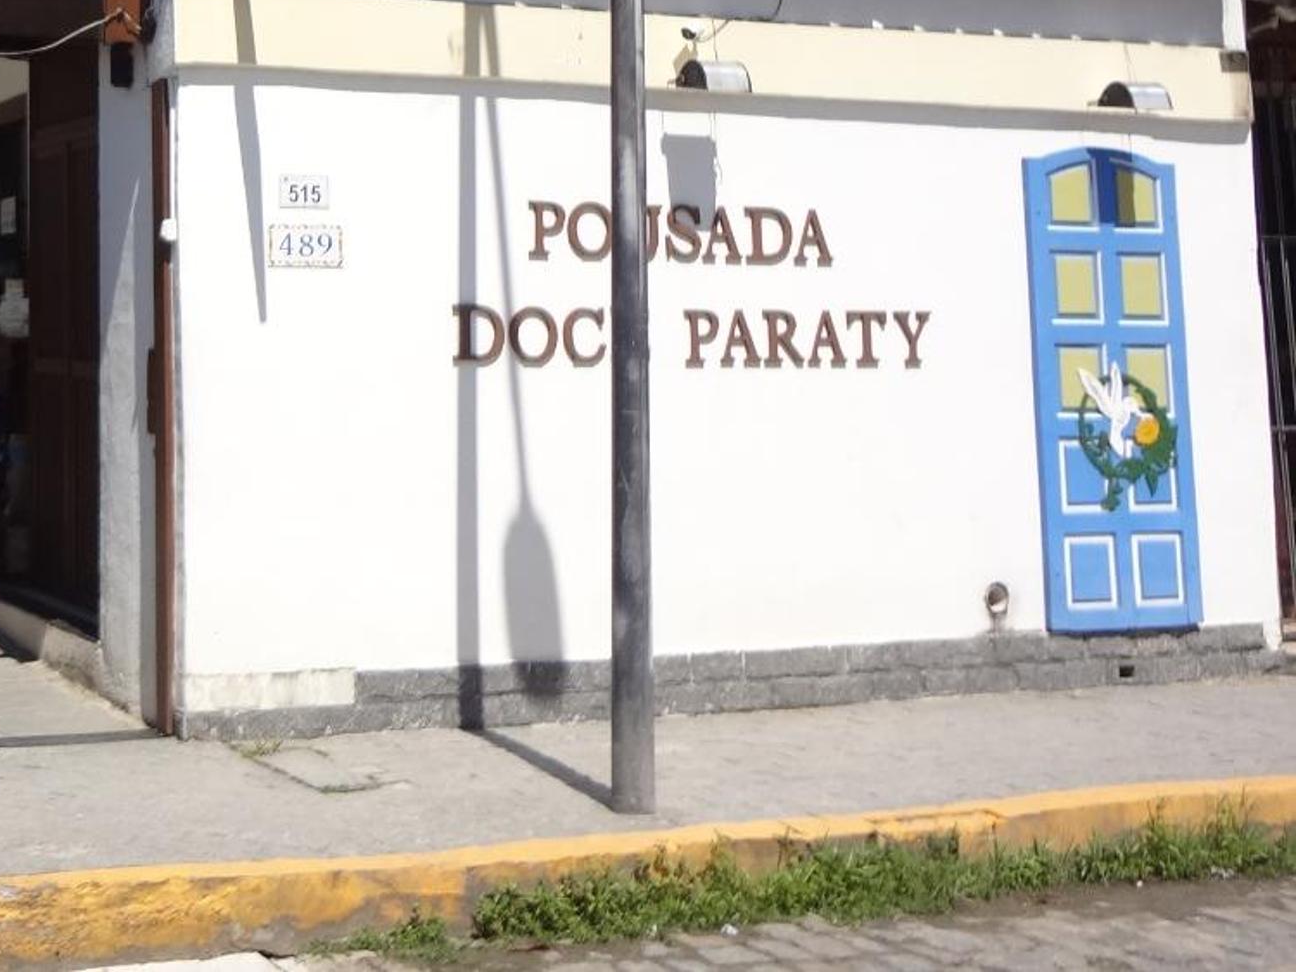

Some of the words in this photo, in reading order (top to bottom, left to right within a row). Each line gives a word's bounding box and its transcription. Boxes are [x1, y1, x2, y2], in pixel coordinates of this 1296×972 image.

[289, 183, 322, 204] 515
[279, 232, 333, 258] 489
[451, 304, 612, 369] DOC
[683, 308, 932, 369] PARATY
